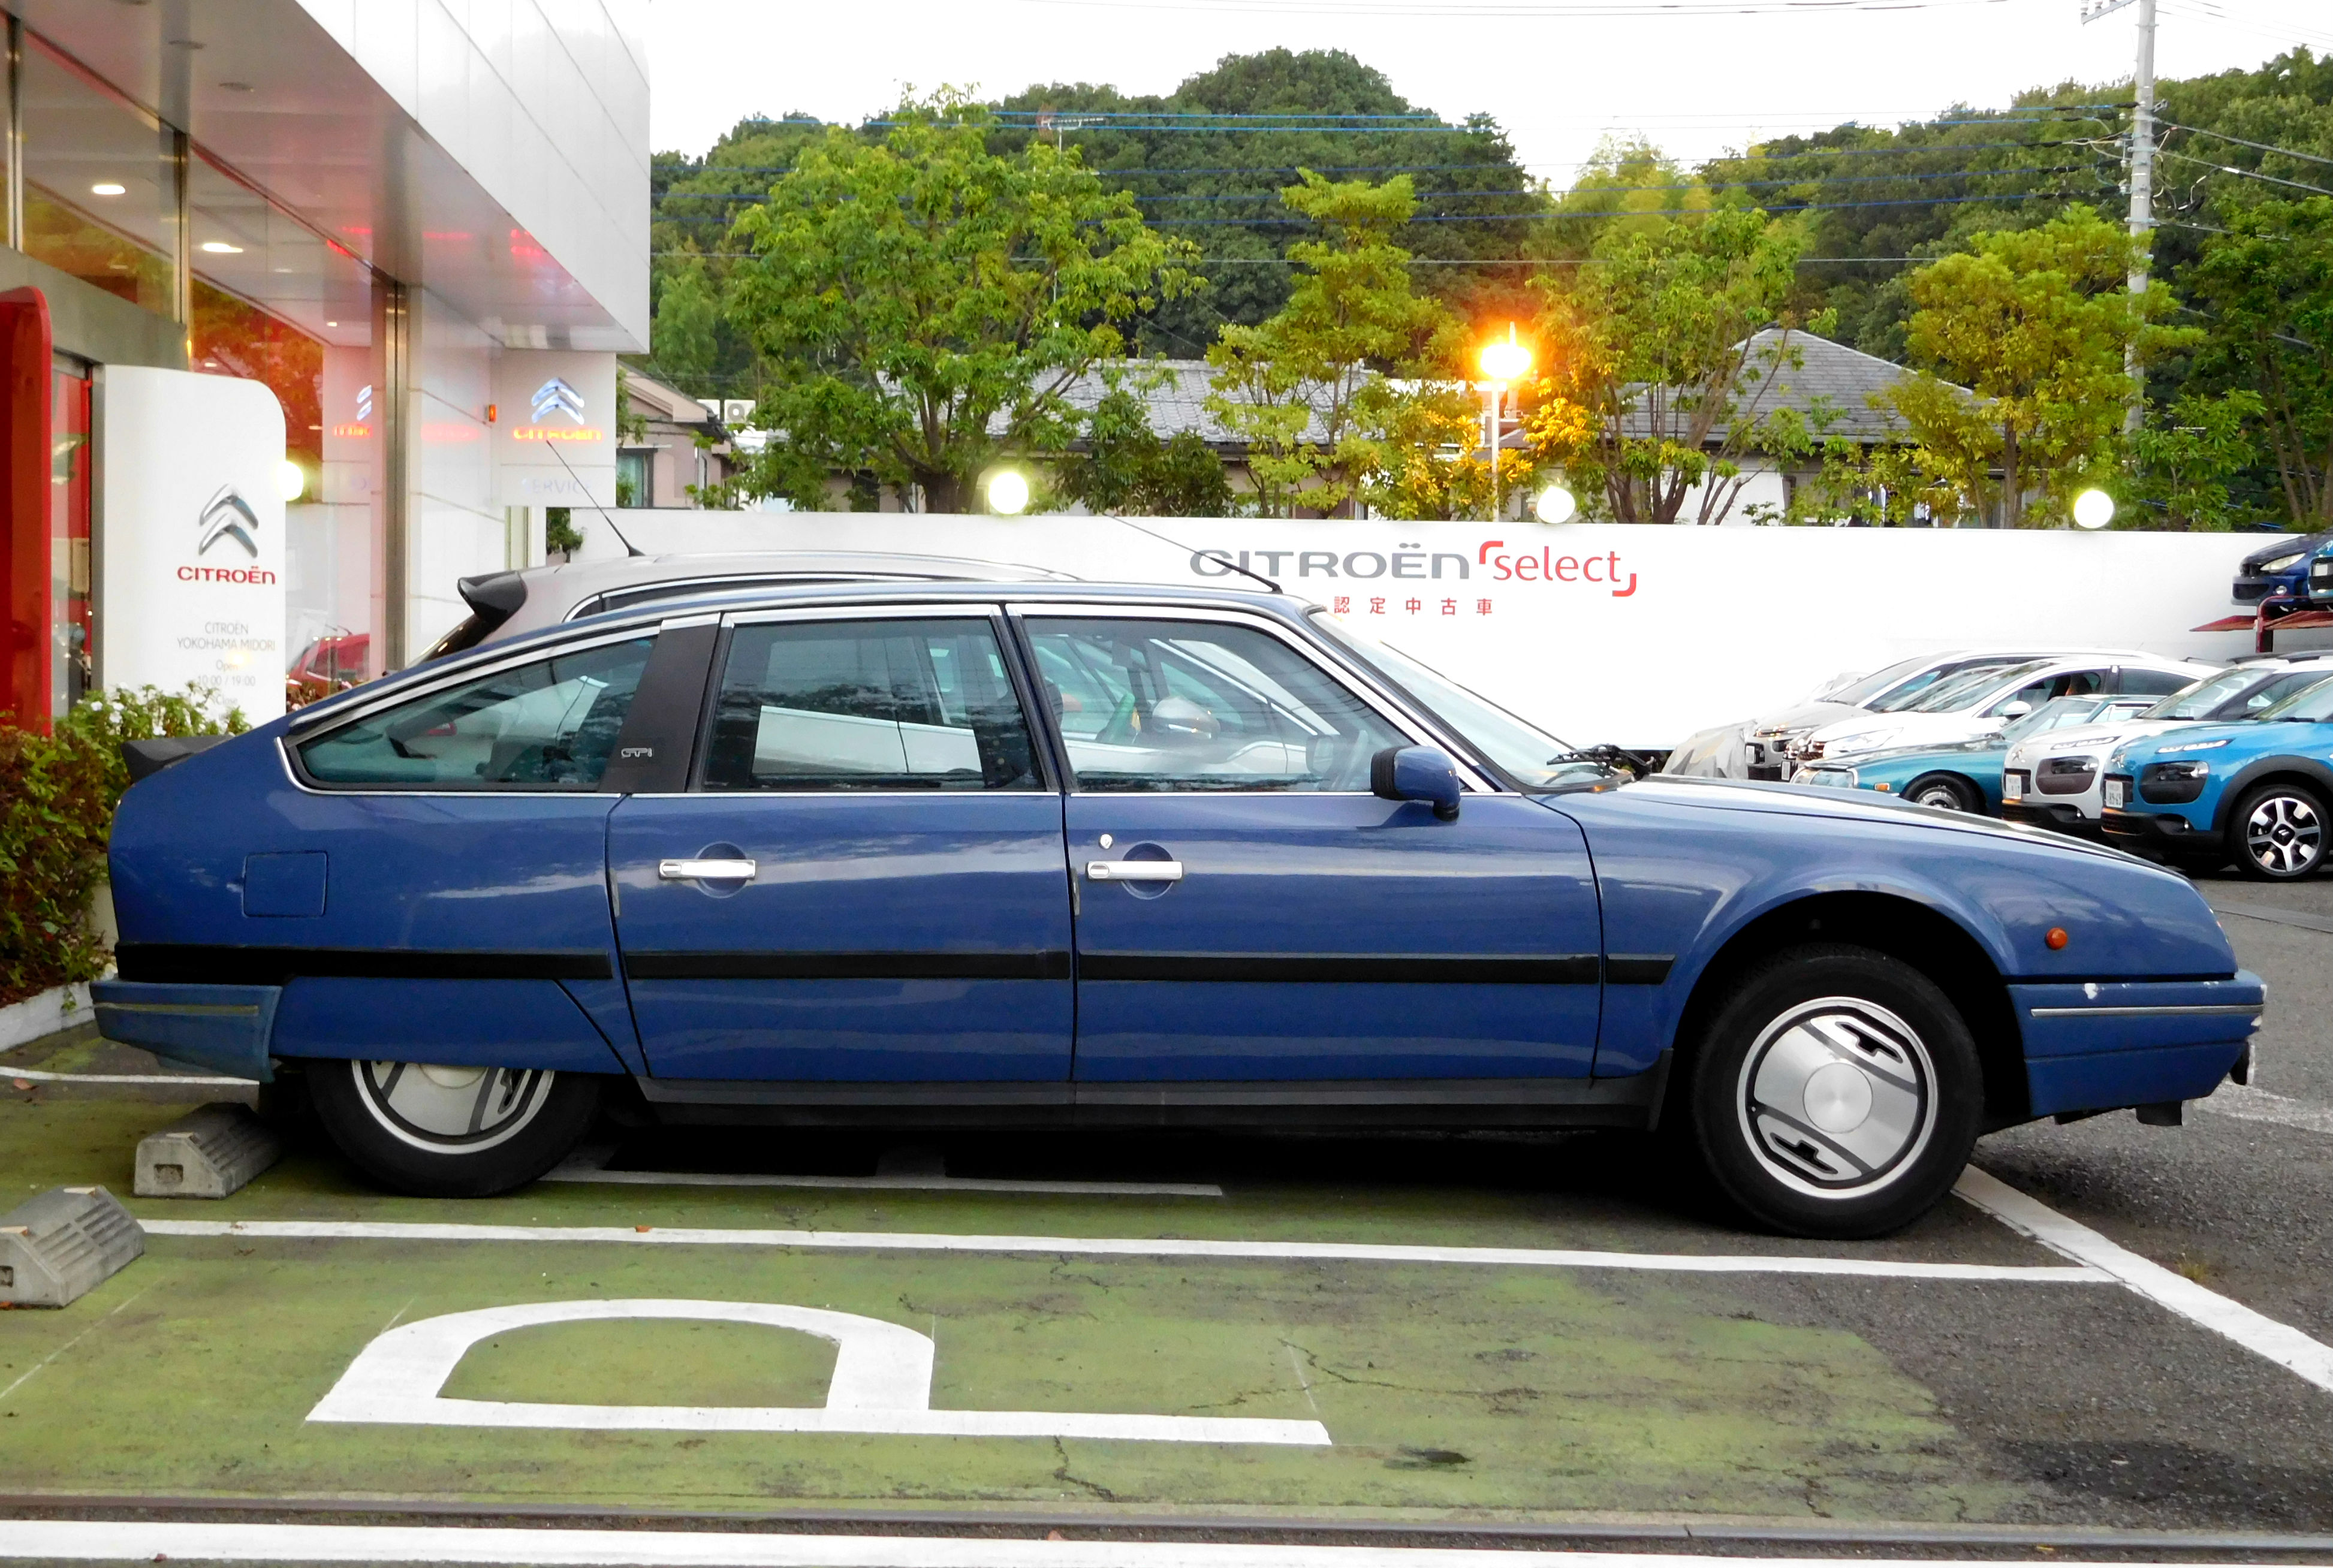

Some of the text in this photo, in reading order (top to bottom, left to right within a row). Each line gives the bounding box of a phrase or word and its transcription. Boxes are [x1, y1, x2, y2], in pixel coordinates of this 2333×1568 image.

[1334, 596, 1493, 616] 認定中古車
[177, 637, 275, 651] YOKOHAMA MIDORI
